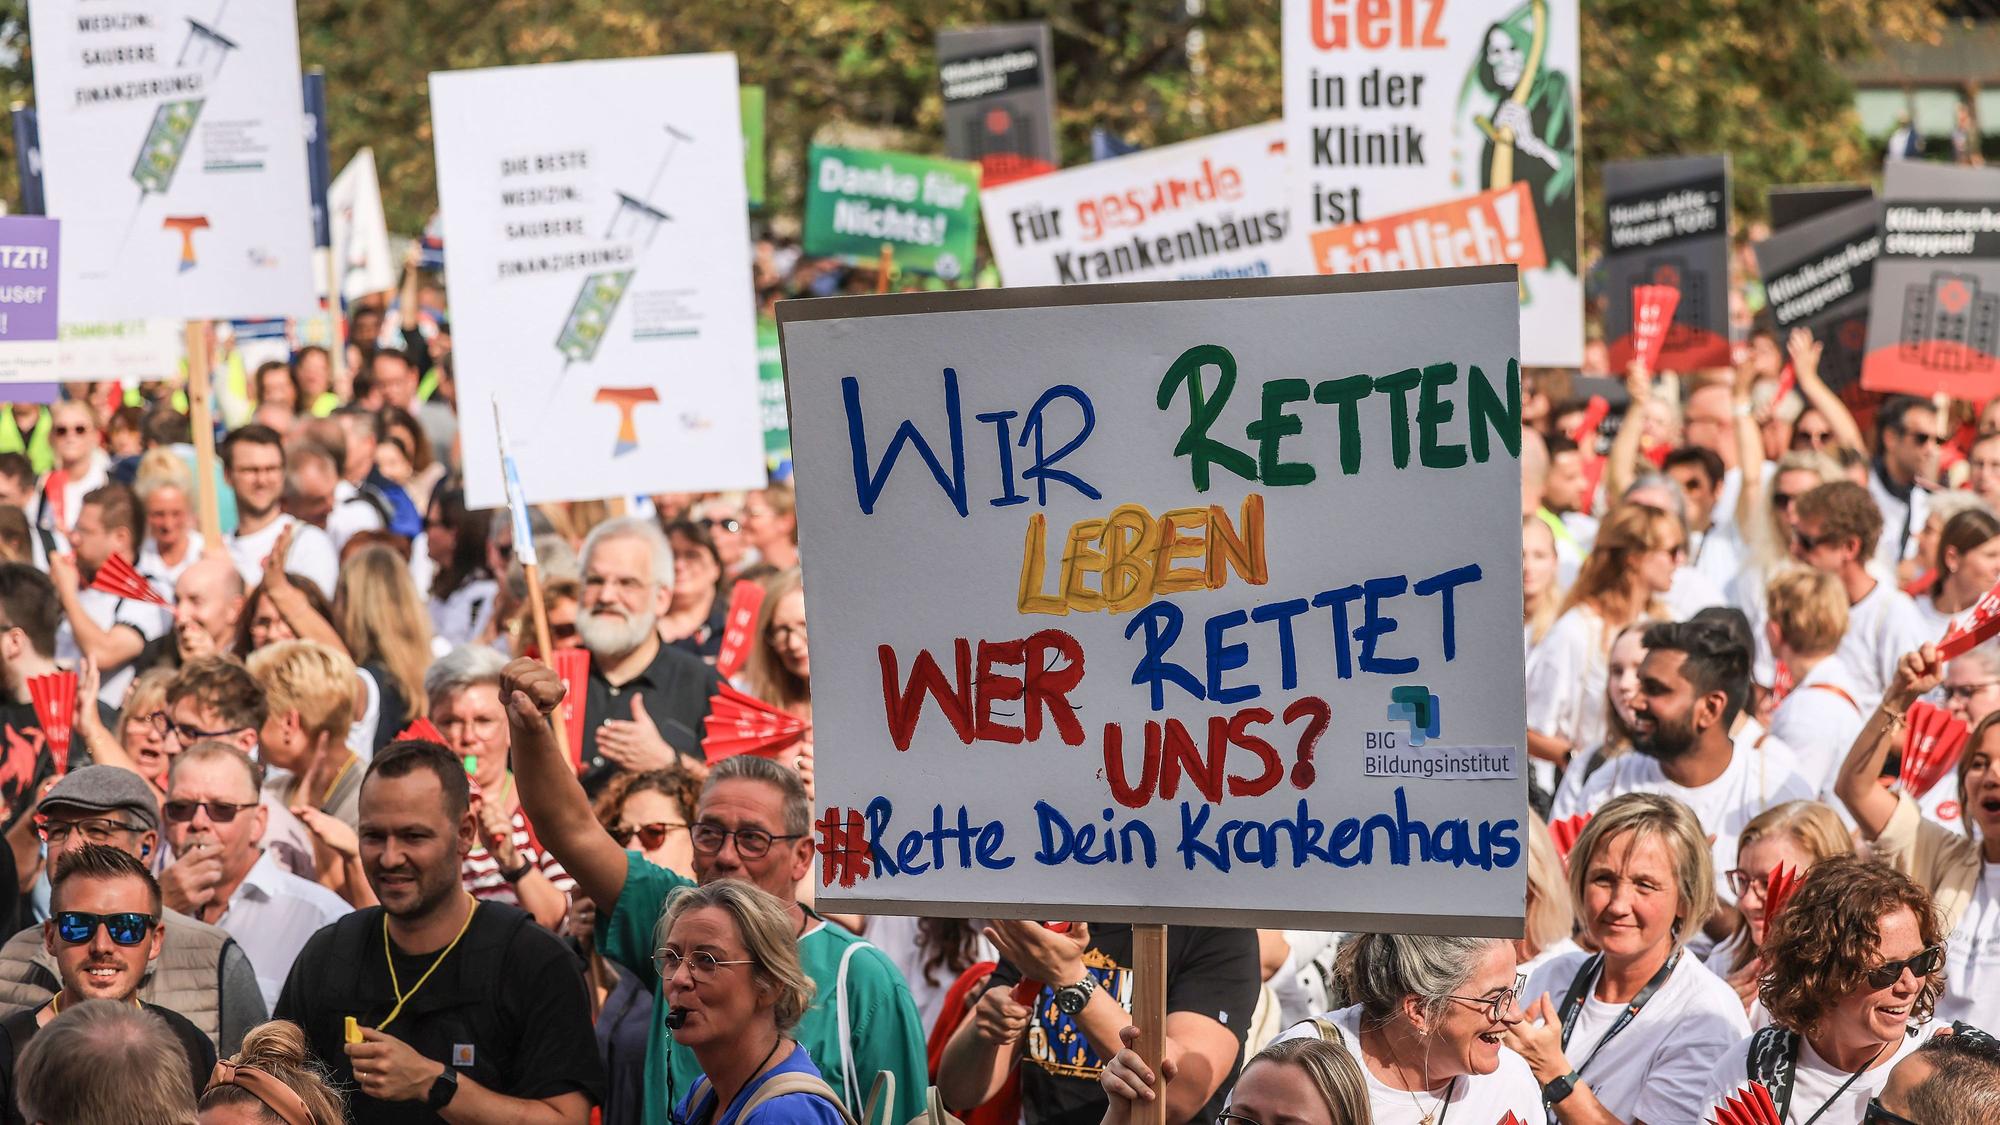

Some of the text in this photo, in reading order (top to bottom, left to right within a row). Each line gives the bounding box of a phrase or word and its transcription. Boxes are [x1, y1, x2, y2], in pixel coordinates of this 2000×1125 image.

[1310, 0, 1447, 51] Geiz
[82, 46, 155, 65] SAUBERE
[1311, 68, 1425, 109] in der
[534, 150, 588, 174] BESTE
[1312, 126, 1425, 166] Klinik
[818, 157, 970, 211] Danke für
[1010, 158, 1245, 245] Für gesunde
[1313, 183, 1362, 225] ist
[833, 198, 948, 247] Nichts!
[1325, 189, 1525, 274] tödlich!
[841, 344, 1522, 518] WIR RETTEN
[1017, 494, 1269, 616] LEBEN
[878, 628, 1086, 752] WER
[1125, 564, 1482, 710] RETTET
[1103, 696, 1332, 808] UNS?
[1366, 731, 1396, 749] BIG
[1366, 754, 1510, 777] Bildungsinstitut
[1033, 800, 1158, 869] Dein
[1177, 787, 1521, 874] Krankenhaus
